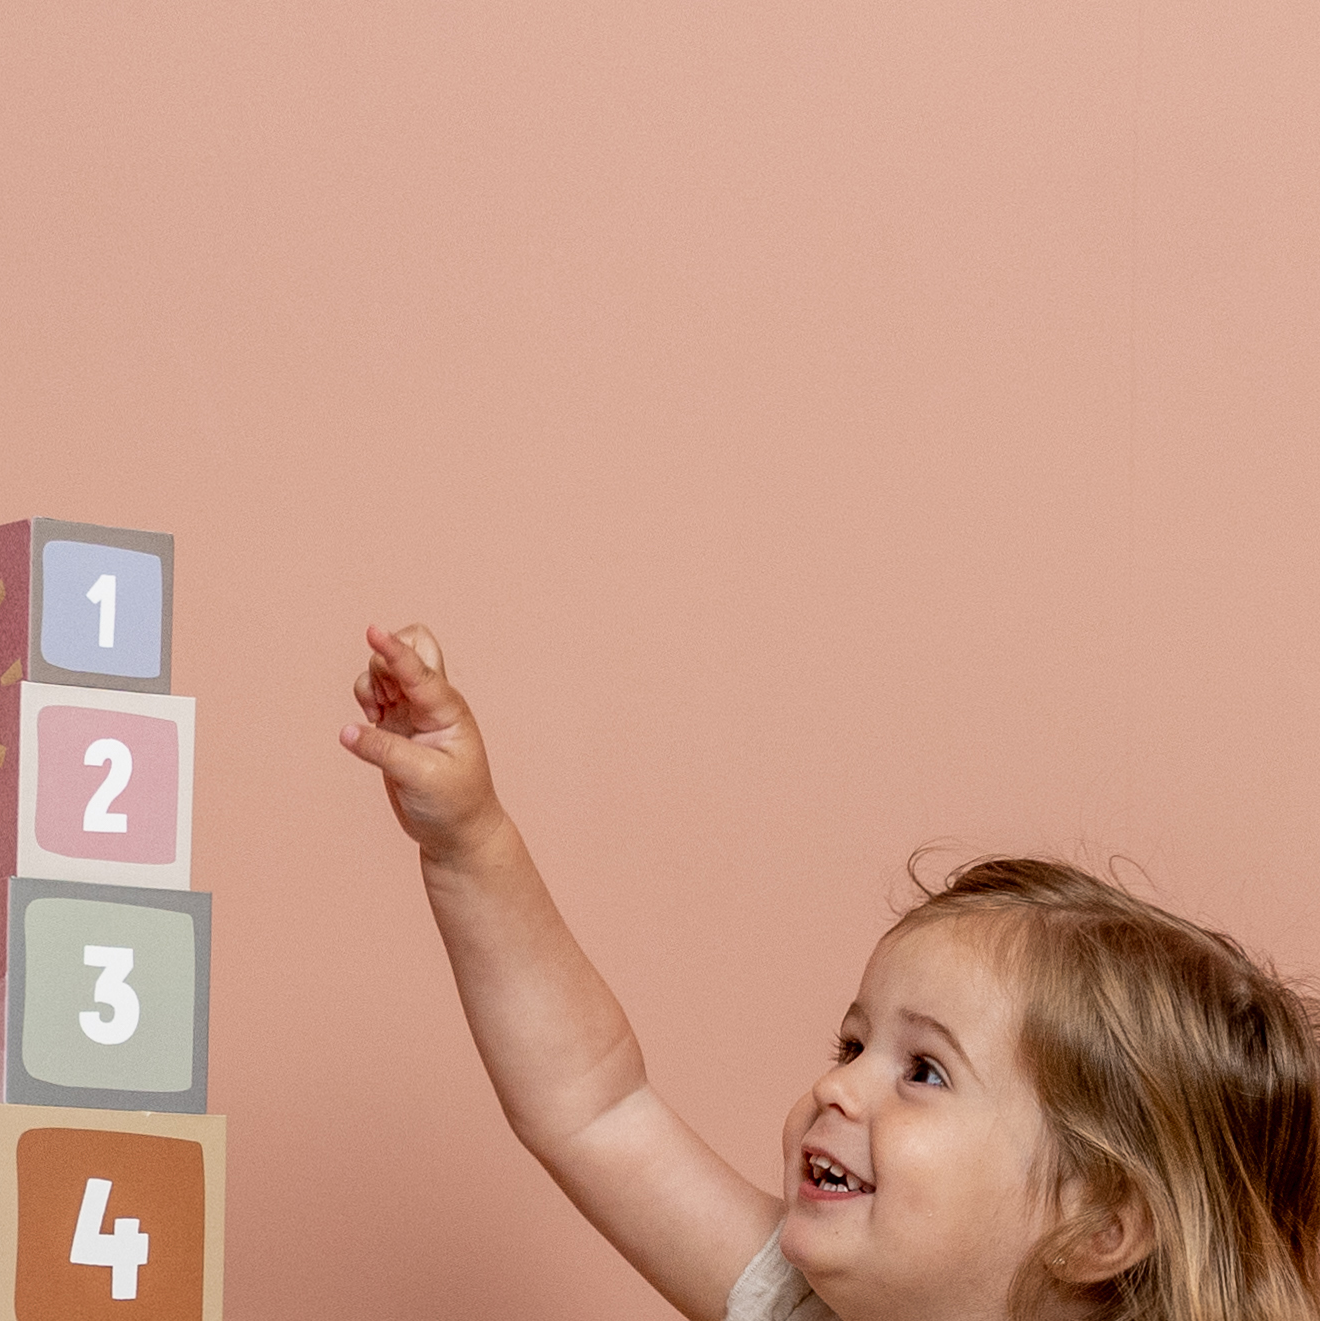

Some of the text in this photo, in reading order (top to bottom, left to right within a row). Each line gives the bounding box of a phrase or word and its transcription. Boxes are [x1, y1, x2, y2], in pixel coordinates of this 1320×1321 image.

[86, 574, 116, 648] 1
[84, 739, 132, 832] 2
[79, 945, 140, 1044] 3
[72, 1180, 147, 1298] 4
